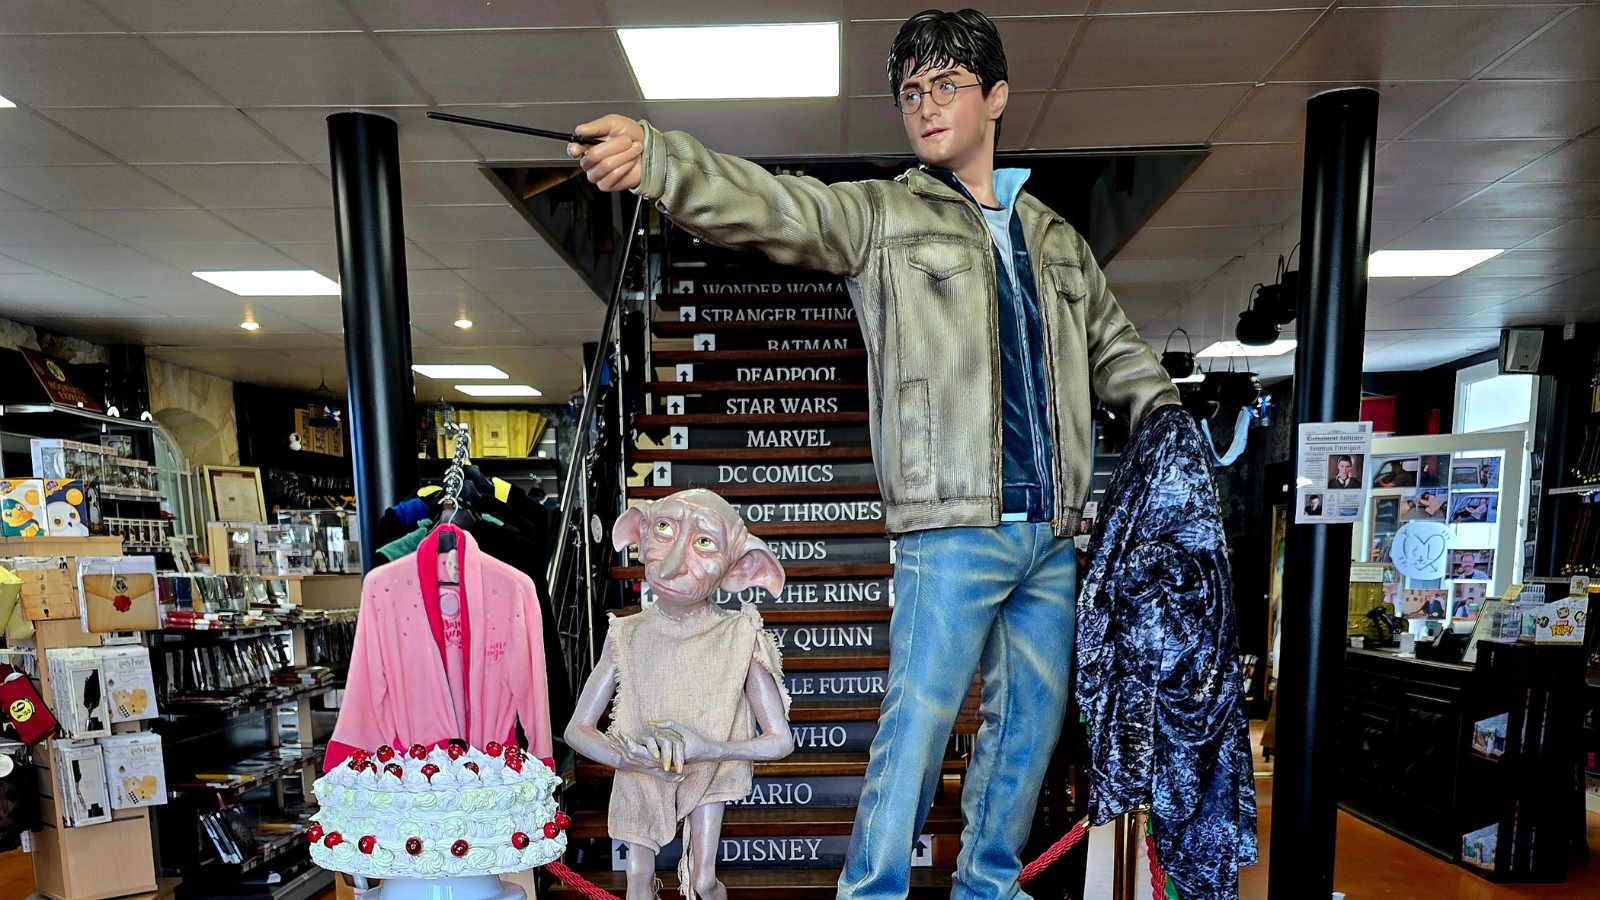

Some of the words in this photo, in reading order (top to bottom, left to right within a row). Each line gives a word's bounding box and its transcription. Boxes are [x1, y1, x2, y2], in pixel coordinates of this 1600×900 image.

[787, 283, 844, 293] WOMA
[701, 308, 797, 322] STRANGER
[800, 307, 858, 321] THING
[767, 338, 848, 351] BATMAN
[736, 366, 842, 382] DEADPOOL
[726, 397, 776, 415] STAR
[780, 397, 838, 413] WARS
[746, 429, 832, 448] MARVEL
[718, 465, 748, 483] DC
[752, 464, 834, 483] COMICS
[746, 503, 776, 522] OF
[780, 501, 883, 522] THRONES
[767, 540, 827, 560] ENDS
[823, 582, 882, 603] RING
[793, 626, 874, 651] QUINN
[790, 678, 814, 695] LE
[818, 676, 885, 695] FUTUR
[791, 725, 847, 747] WHO
[725, 782, 813, 806] ARIO
[721, 838, 823, 862] DISNEY
